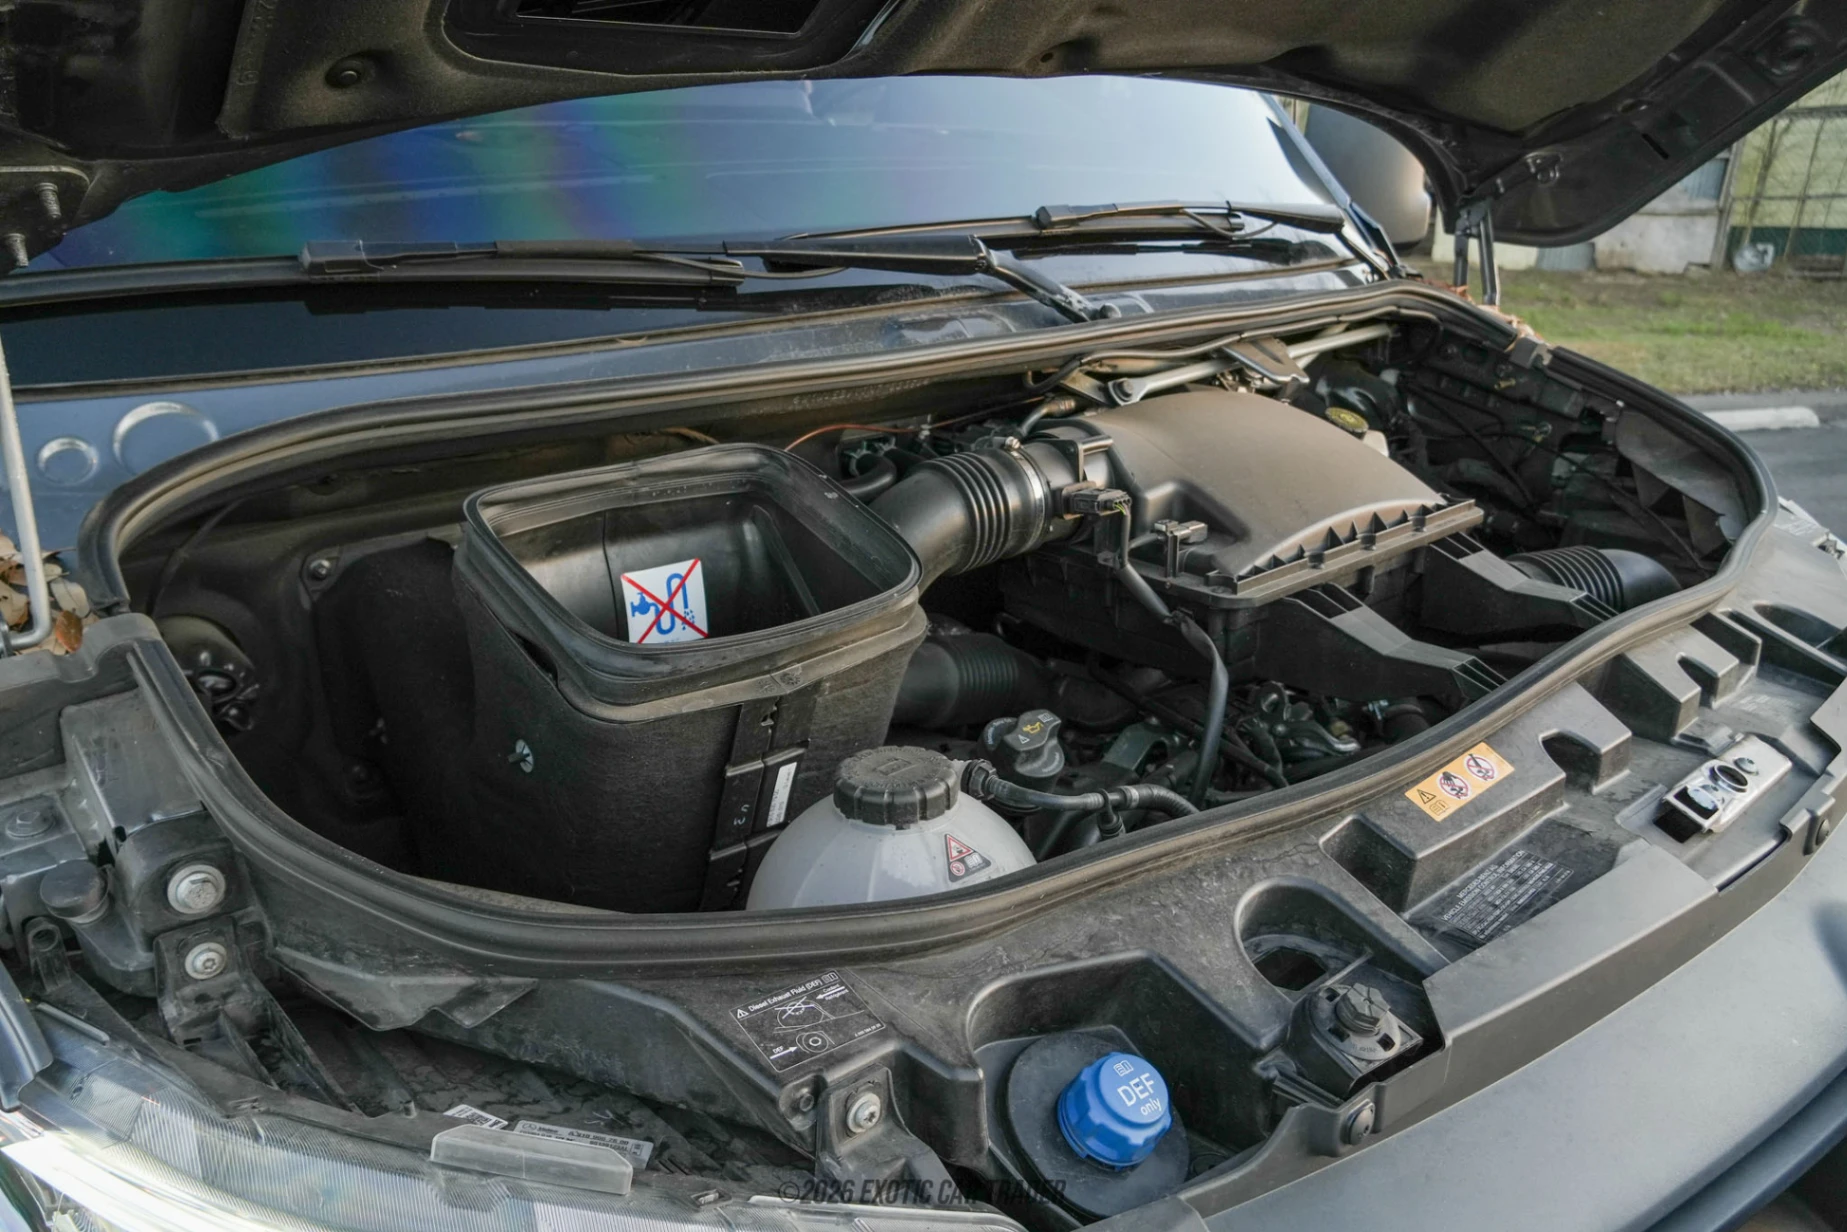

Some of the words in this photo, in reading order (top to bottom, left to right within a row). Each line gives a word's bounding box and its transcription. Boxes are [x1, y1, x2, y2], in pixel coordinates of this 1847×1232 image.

[1442, 903, 1463, 921] VEHICLE
[1460, 887, 1481, 907] EMISSION
[1479, 872, 1499, 890] CONTROL
[1497, 850, 1526, 873] INFORMATION
[748, 1000, 769, 1012] Diesel
[767, 991, 791, 1005] Exhaust
[790, 984, 806, 996] Fluid
[772, 1045, 784, 1054] DEF
[1117, 1072, 1155, 1107] DEF
[1140, 1097, 1162, 1116] only
